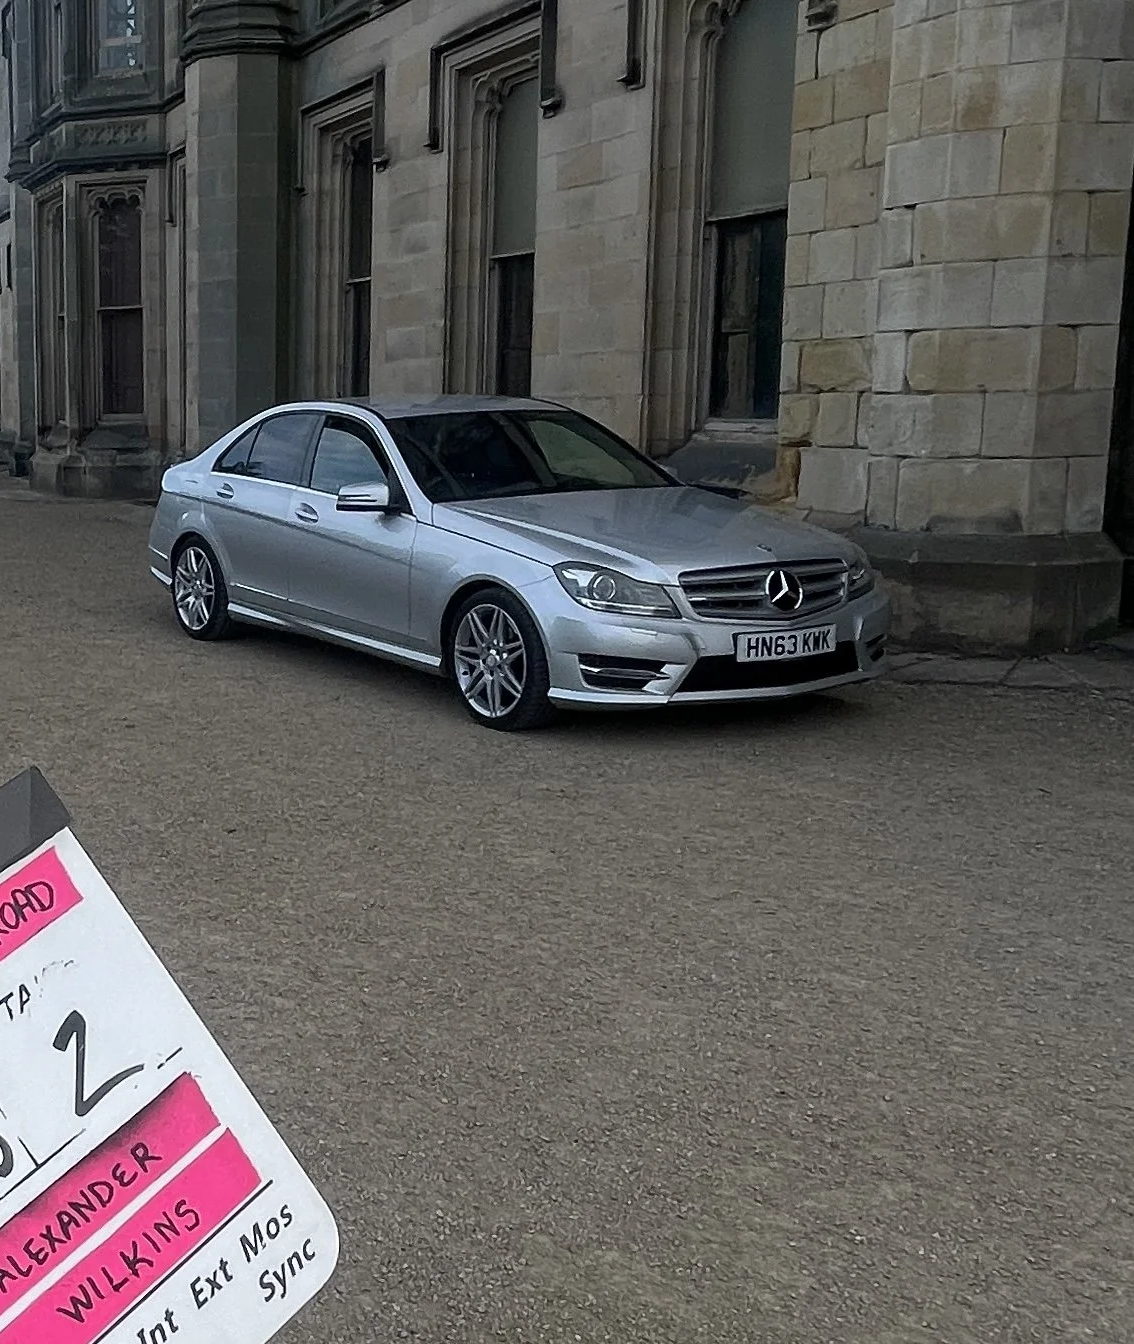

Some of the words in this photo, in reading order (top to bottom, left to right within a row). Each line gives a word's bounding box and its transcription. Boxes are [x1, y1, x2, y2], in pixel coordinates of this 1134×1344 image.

[747, 635, 798, 658] HN63
[802, 629, 831, 653] KWK
[52, 1009, 145, 1118] 2
[56, 1199, 202, 1323] WILKINS
[189, 1257, 234, 1310] Ext
[239, 1204, 293, 1264] Mos
[259, 1238, 316, 1303] Sync
